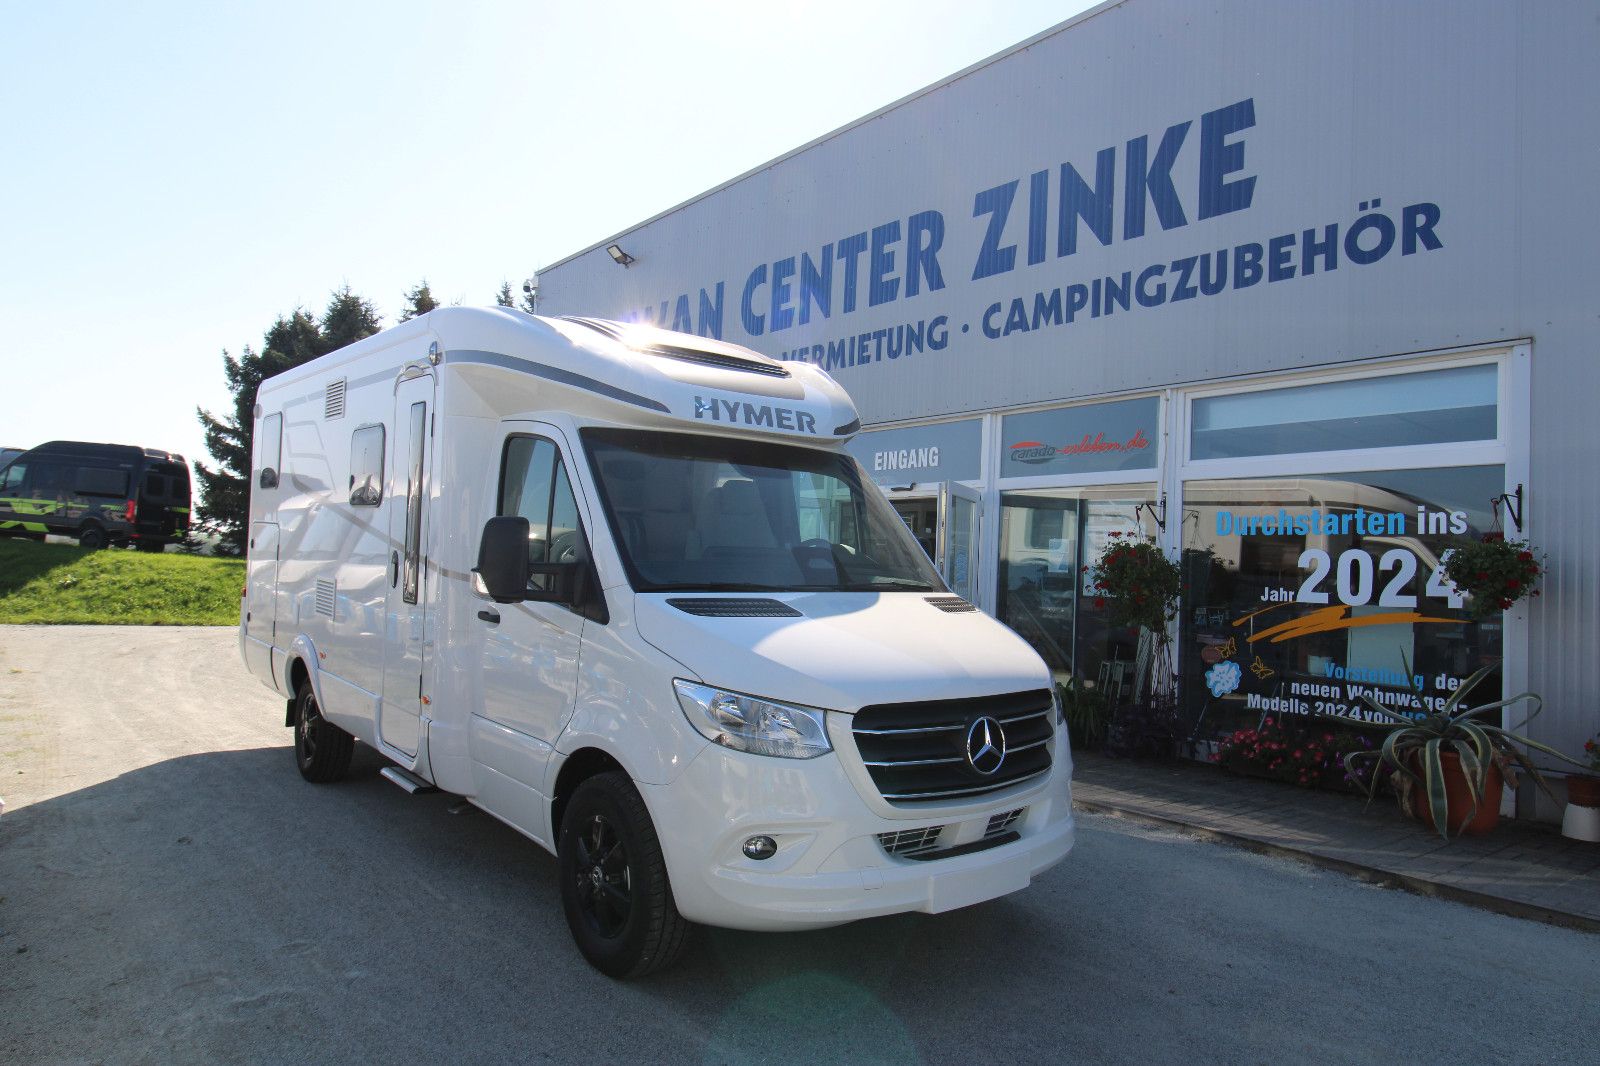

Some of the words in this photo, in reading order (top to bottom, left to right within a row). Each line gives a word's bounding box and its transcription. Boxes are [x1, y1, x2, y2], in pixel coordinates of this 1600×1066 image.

[741, 209, 946, 337] CENTER
[970, 97, 1258, 282] ZINKE
[982, 198, 1444, 339] CAMPINGZUBEHÖR
[694, 395, 817, 434] HYMER
[874, 446, 940, 471] EINGANG
[1215, 508, 1406, 537] Durchstarten
[1417, 505, 1468, 535] ins
[1260, 587, 1295, 602] Jahr
[1296, 549, 1469, 608] 2024
[1247, 693, 1309, 715] Modelle
[1314, 701, 1362, 721] 2024
[1291, 682, 1341, 699] neuen
